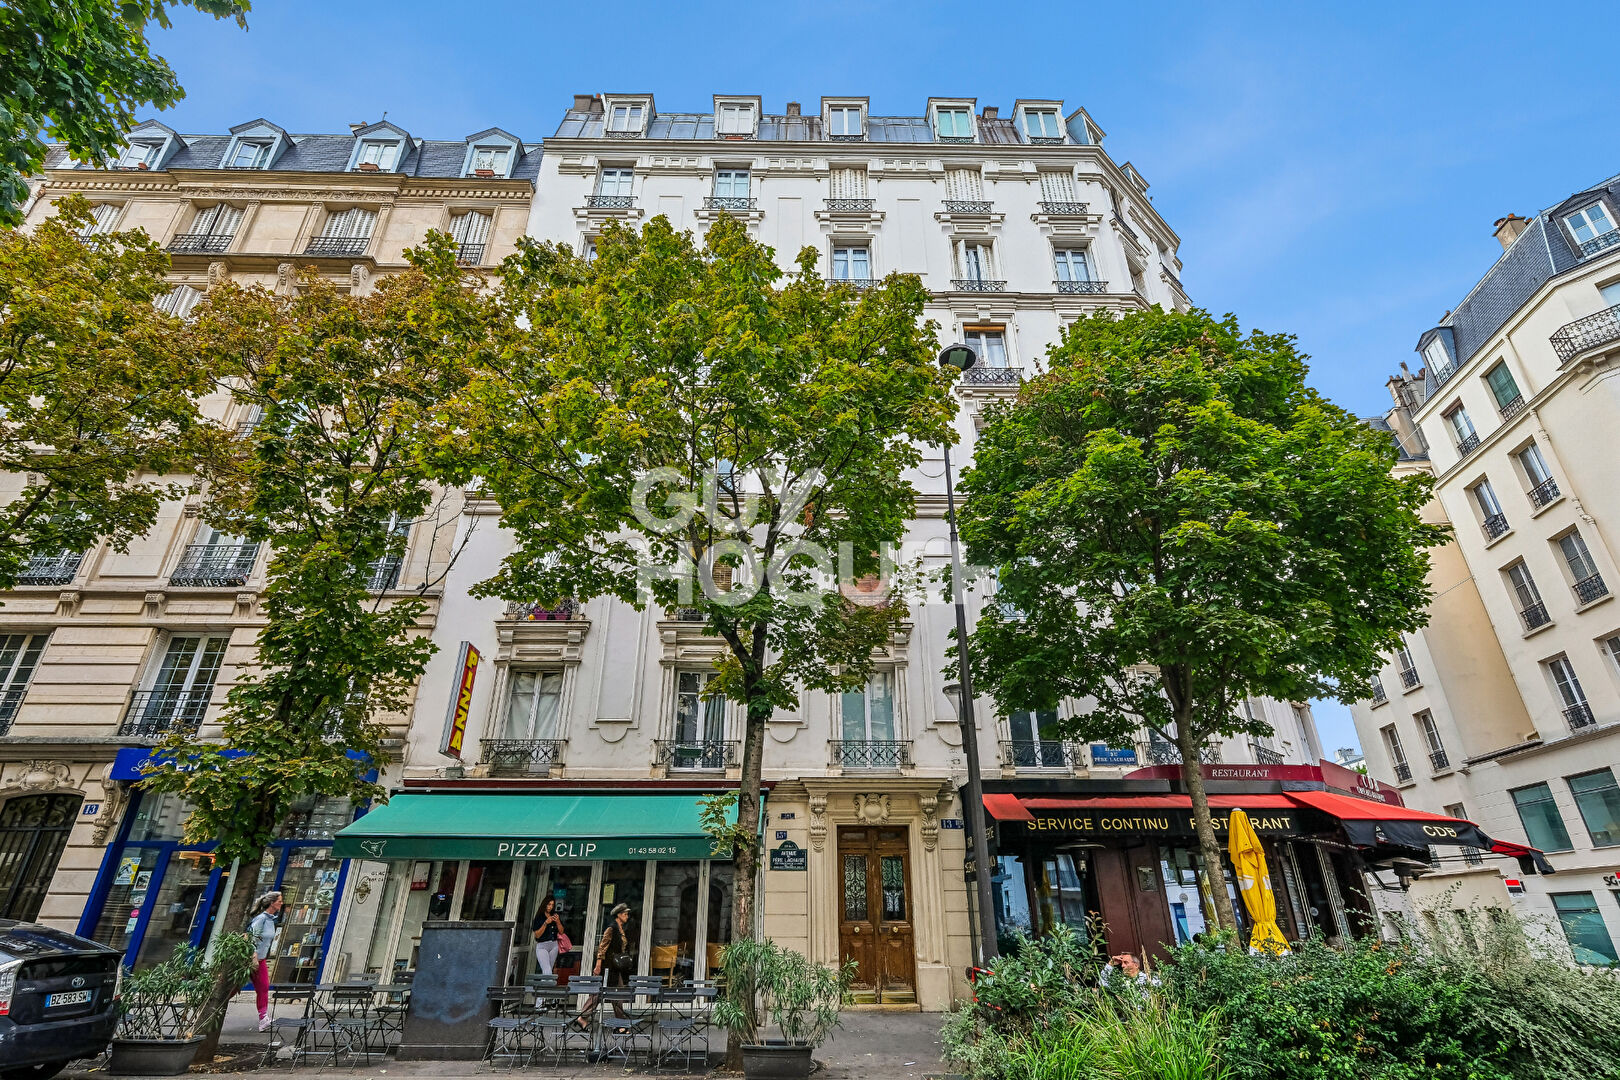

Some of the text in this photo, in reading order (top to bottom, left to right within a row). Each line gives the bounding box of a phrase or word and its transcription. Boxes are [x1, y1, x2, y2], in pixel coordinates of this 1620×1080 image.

[449, 648, 478, 751] PIZZA
[1211, 769, 1270, 778] RESTAURANT
[84, 804, 96, 815] 13
[942, 820, 952, 828] 13
[1027, 817, 1290, 831] SERVICE CONTINU RSTRANT
[1422, 824, 1458, 838] CDB
[497, 842, 550, 858] PIZZA
[555, 842, 597, 858] CLIP
[1603, 875, 1619, 886] SG
